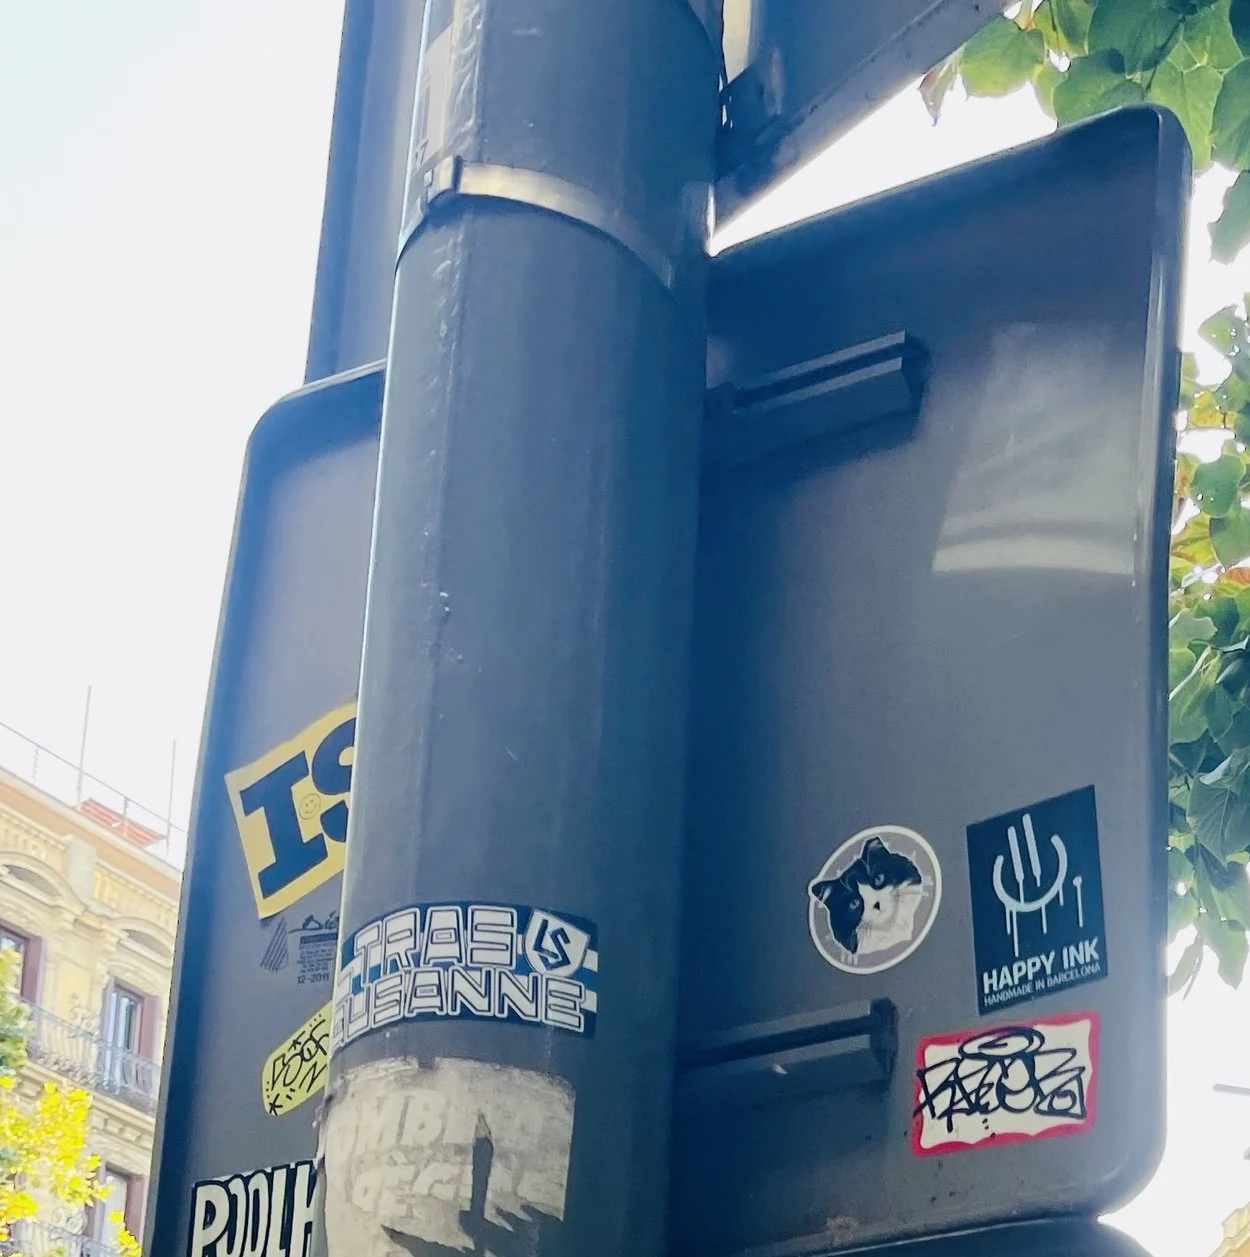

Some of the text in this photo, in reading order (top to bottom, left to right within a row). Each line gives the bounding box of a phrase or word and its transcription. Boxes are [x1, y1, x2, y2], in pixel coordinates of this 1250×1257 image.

[983, 936, 1099, 994] HAPPY INK
[984, 962, 1101, 1007] HANDMADE IN BARCELONA
